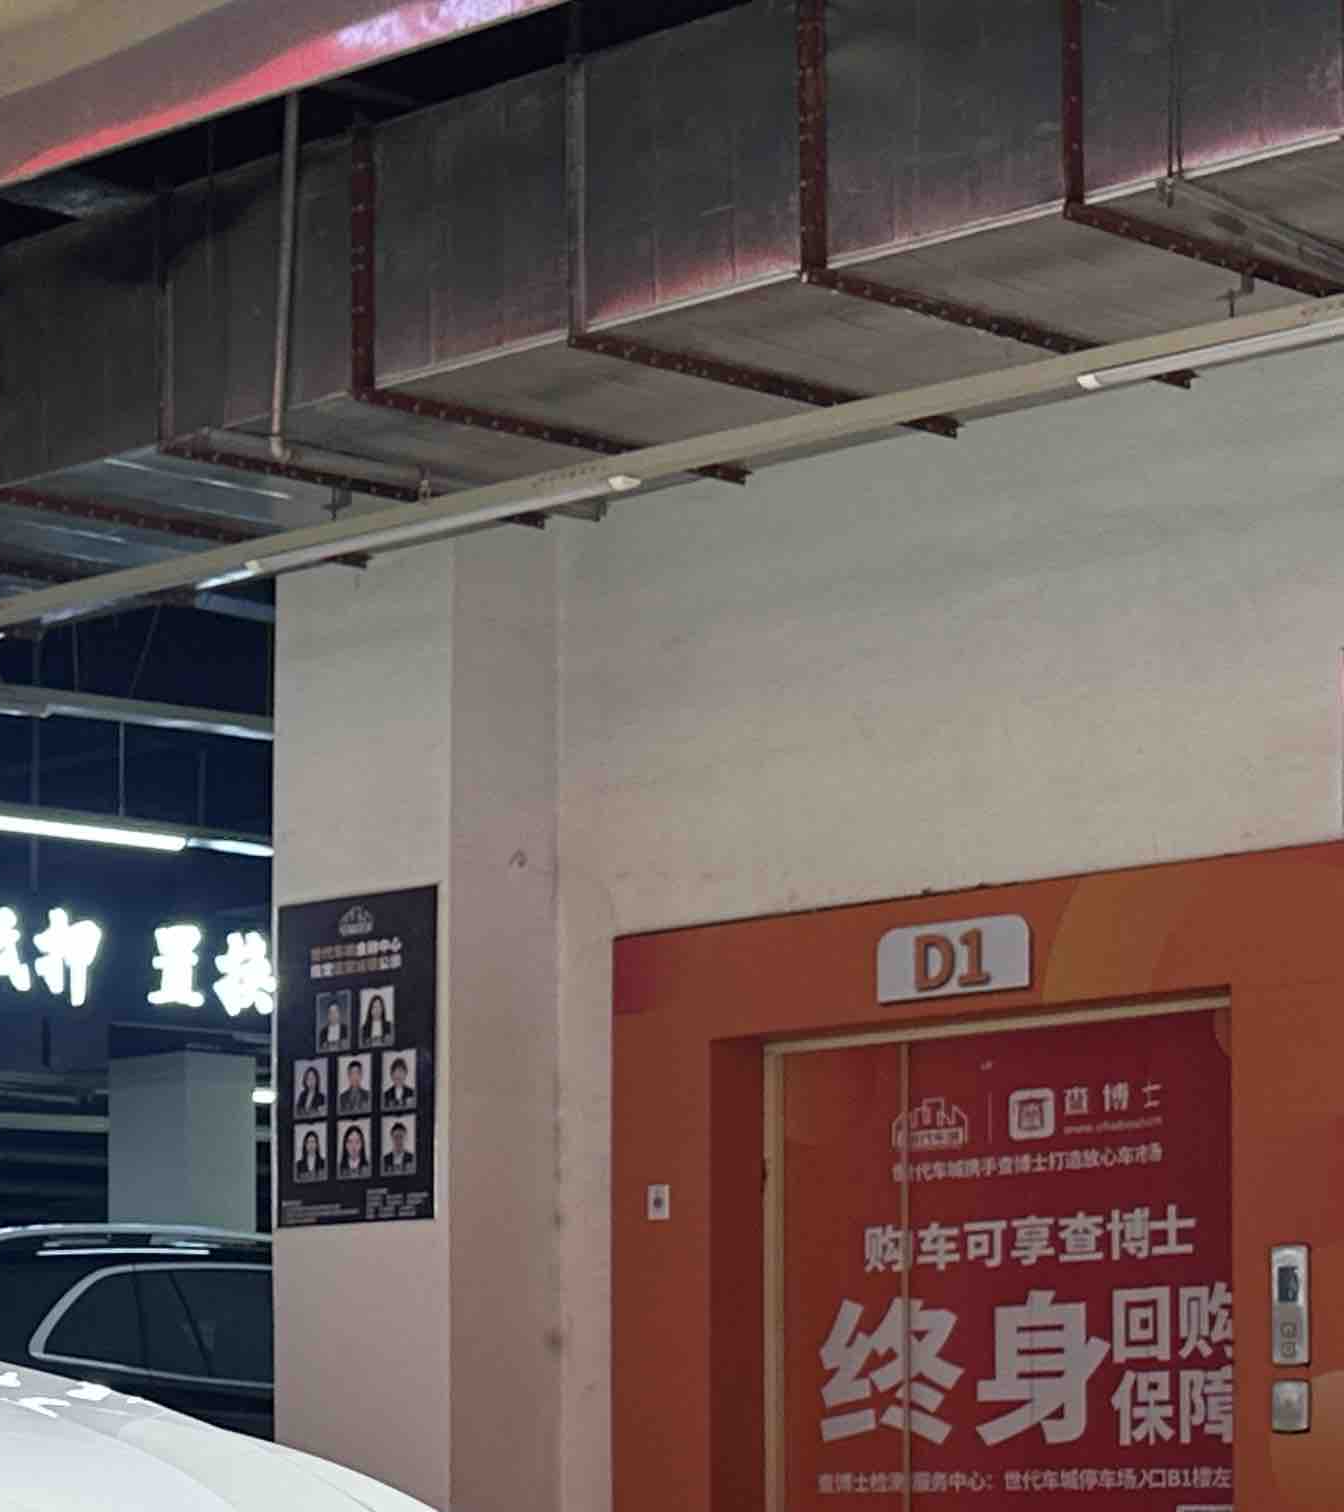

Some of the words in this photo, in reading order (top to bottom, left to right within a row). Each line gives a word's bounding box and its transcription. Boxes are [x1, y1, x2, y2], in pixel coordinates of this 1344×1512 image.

[914, 926, 991, 992] D1
[863, 1204, 1196, 1274] 购车可享查博士
[818, 1289, 1111, 1448] 终身
[1111, 1367, 1233, 1447] 保障
